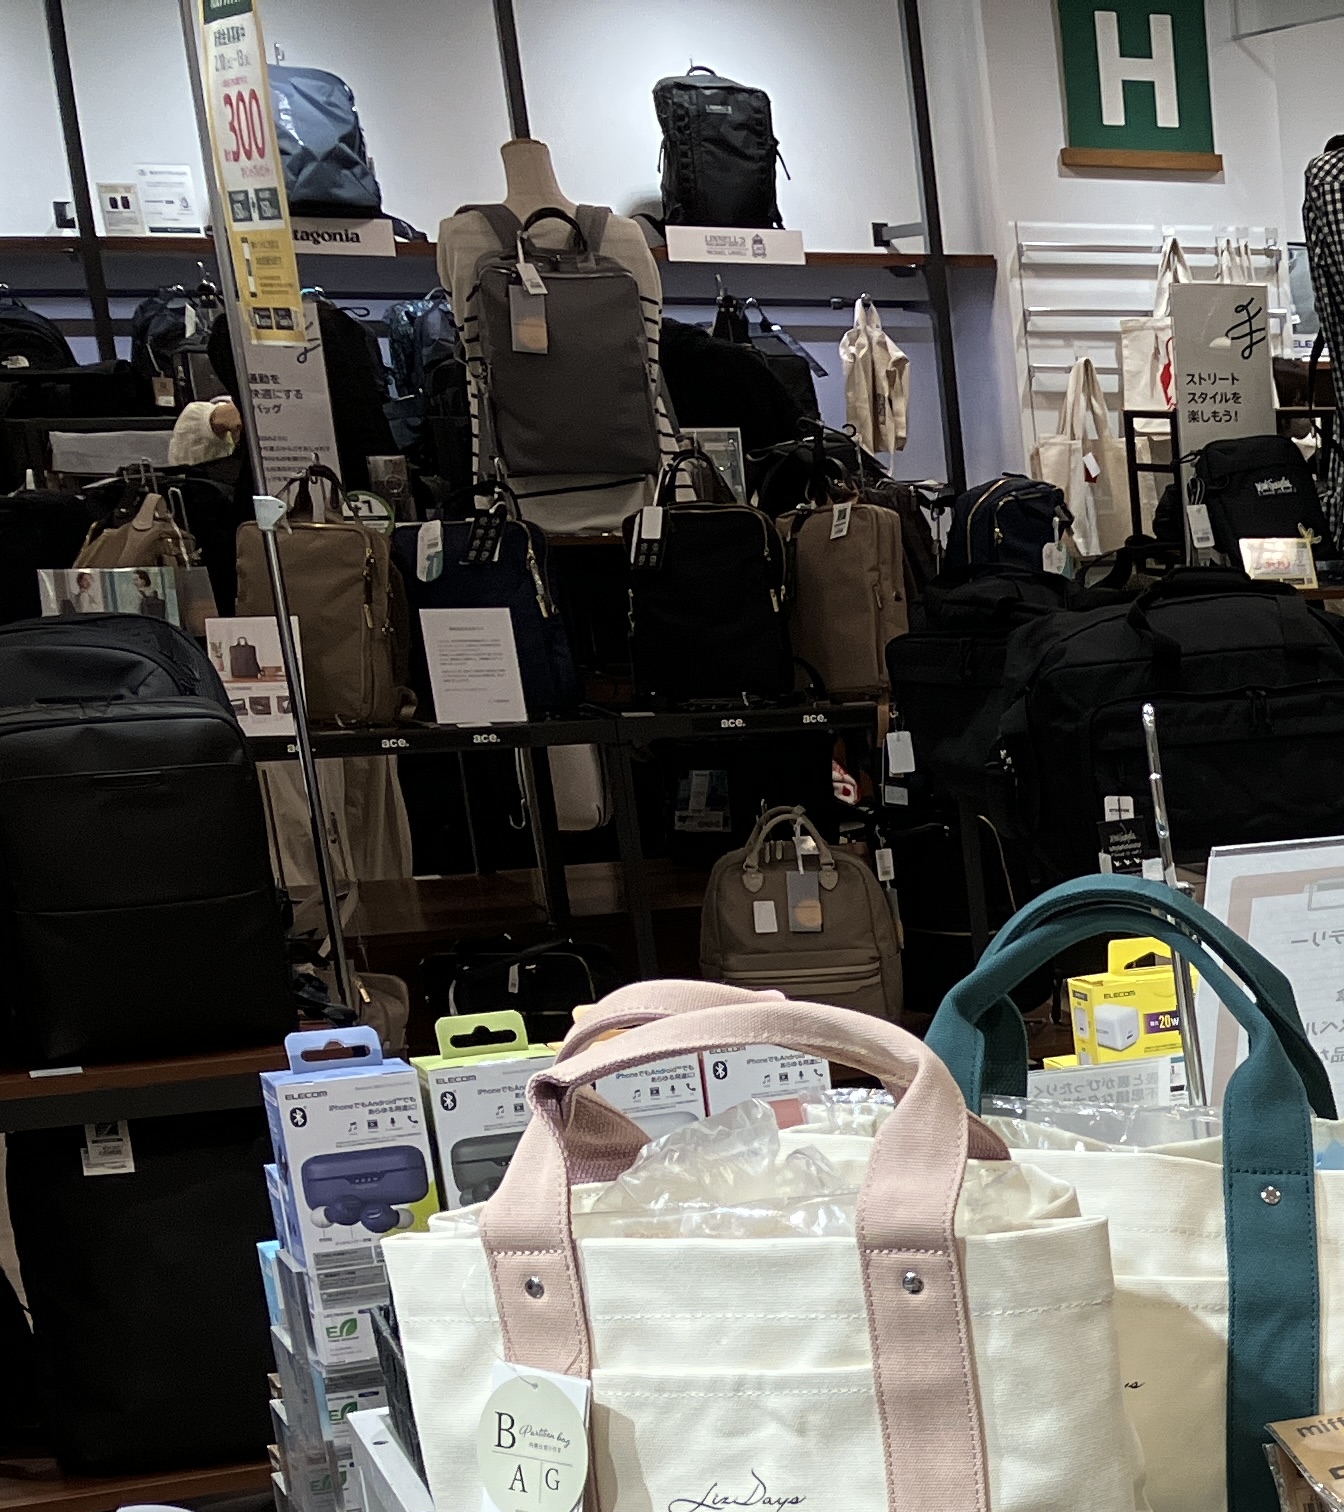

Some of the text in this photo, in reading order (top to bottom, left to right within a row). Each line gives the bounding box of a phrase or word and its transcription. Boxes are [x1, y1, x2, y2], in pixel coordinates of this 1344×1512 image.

[1094, 10, 1180, 128] H
[223, 88, 266, 162] 300
[293, 227, 361, 246] tagonia
[1186, 373, 1240, 387] ストリート
[1187, 391, 1242, 405] スタイルを
[1187, 409, 1239, 423] 楽しもう!
[381, 735, 410, 749] ace.
[473, 731, 501, 744] ace.
[435, 1074, 477, 1086] ELECOM
[284, 1090, 328, 1101] ELECOM
[494, 1411, 516, 1449] B
[508, 1463, 560, 1494] A G
